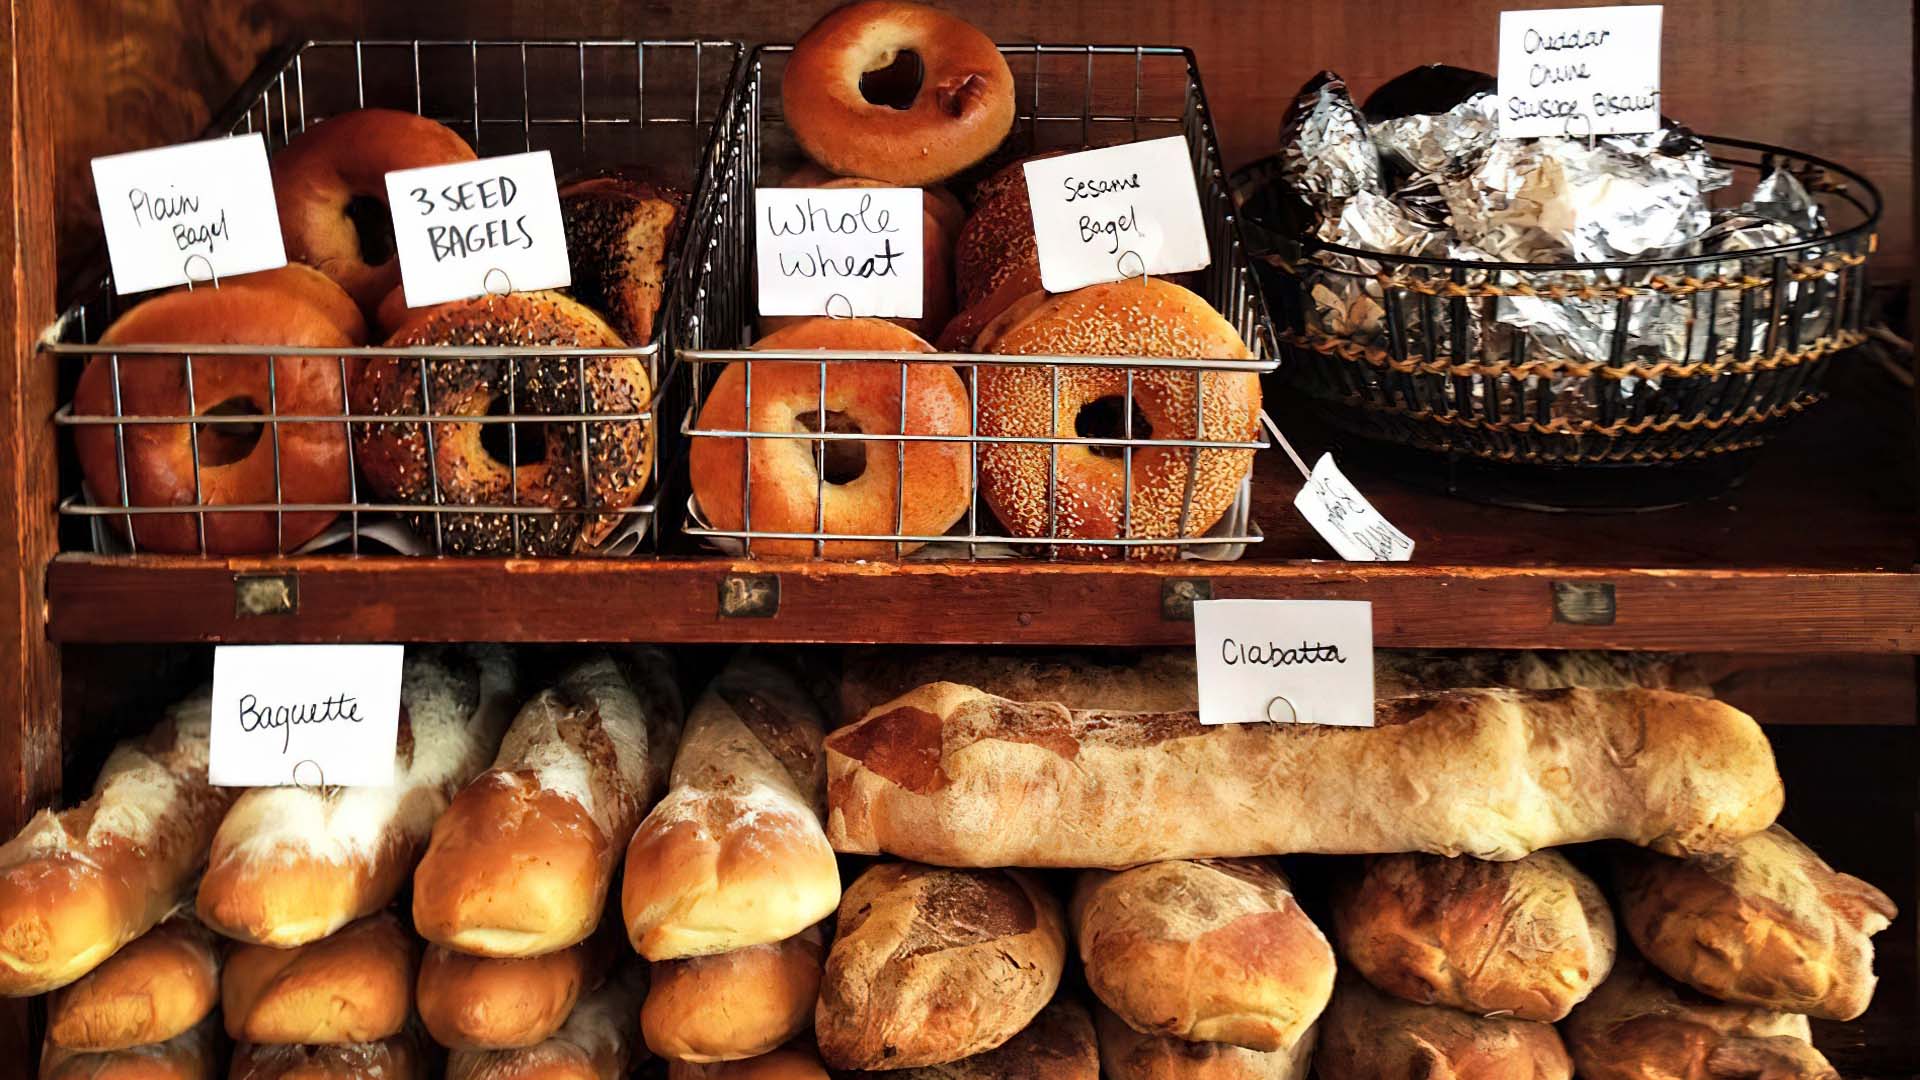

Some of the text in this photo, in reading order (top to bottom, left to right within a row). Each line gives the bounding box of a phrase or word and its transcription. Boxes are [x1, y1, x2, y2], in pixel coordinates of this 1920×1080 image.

[129, 184, 200, 229] Plain
[410, 176, 517, 216] 3 SEED
[1064, 173, 1141, 202] Sesame
[173, 209, 229, 253] Bagel
[768, 193, 900, 237] Whole
[1079, 204, 1139, 254] Bagel
[427, 215, 533, 262] BAGELS
[240, 692, 364, 755] Baguette
